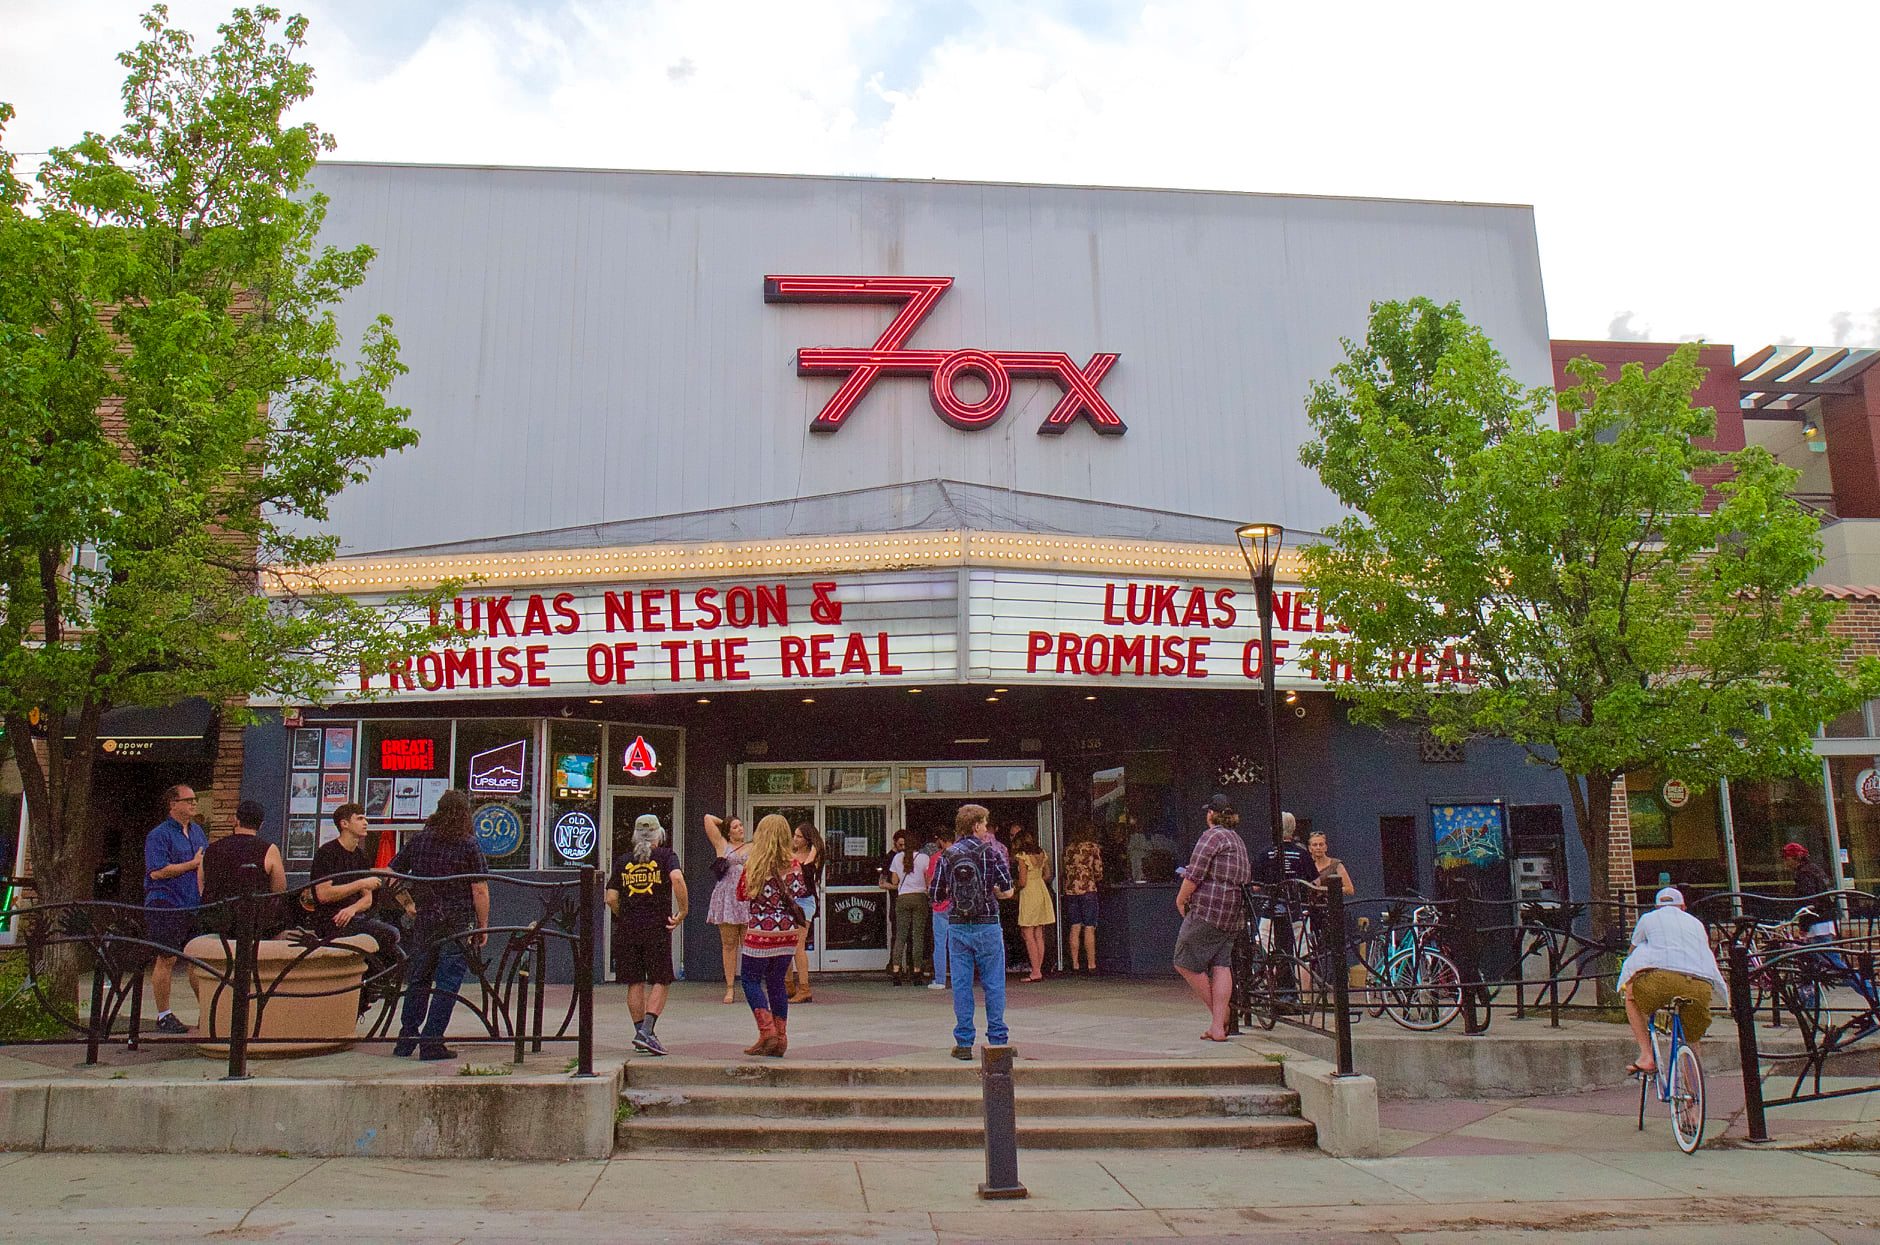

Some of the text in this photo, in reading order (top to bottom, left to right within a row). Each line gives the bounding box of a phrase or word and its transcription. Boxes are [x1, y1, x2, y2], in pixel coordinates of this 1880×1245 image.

[604, 584, 788, 633] NELSON
[809, 581, 843, 625] &
[1103, 583, 1237, 628] LUKAS
[587, 641, 638, 686] OF
[660, 638, 751, 683] THE
[780, 632, 903, 678] REAL
[1026, 630, 1211, 678] PROMISE
[1241, 638, 1290, 680] OF
[1390, 644, 1478, 685] REAL
[381, 739, 426, 754] GREAT
[623, 735, 657, 772] A
[382, 754, 428, 771] DIVIDE
[475, 777, 519, 787] UPSLOPE
[568, 816, 585, 825] OLD
[621, 872, 648, 887] TWISTED
